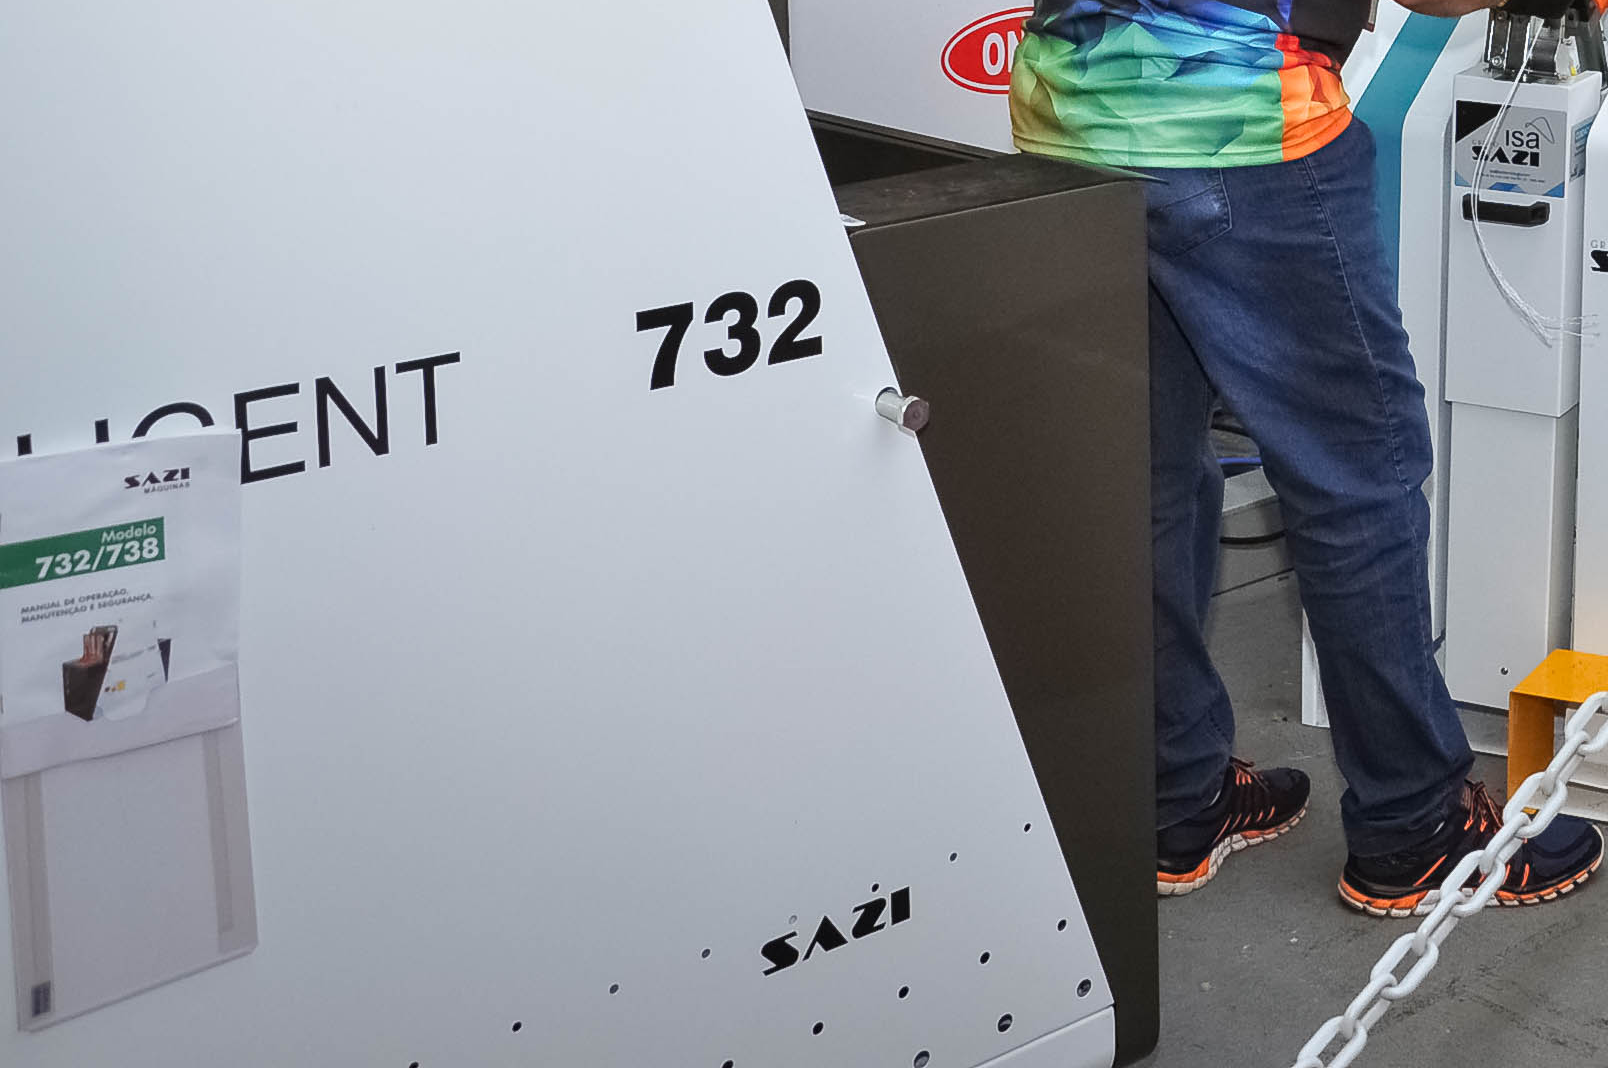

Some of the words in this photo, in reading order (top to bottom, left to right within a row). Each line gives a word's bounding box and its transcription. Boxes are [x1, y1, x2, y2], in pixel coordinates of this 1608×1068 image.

[1471, 145, 1540, 167] SAZI
[635, 278, 823, 391] 732
[124, 467, 190, 489] SAZI
[101, 523, 157, 543] Modelo
[35, 537, 159, 579] 732/738
[21, 600, 61, 614] MANUAL
[760, 886, 911, 976] SAZI
